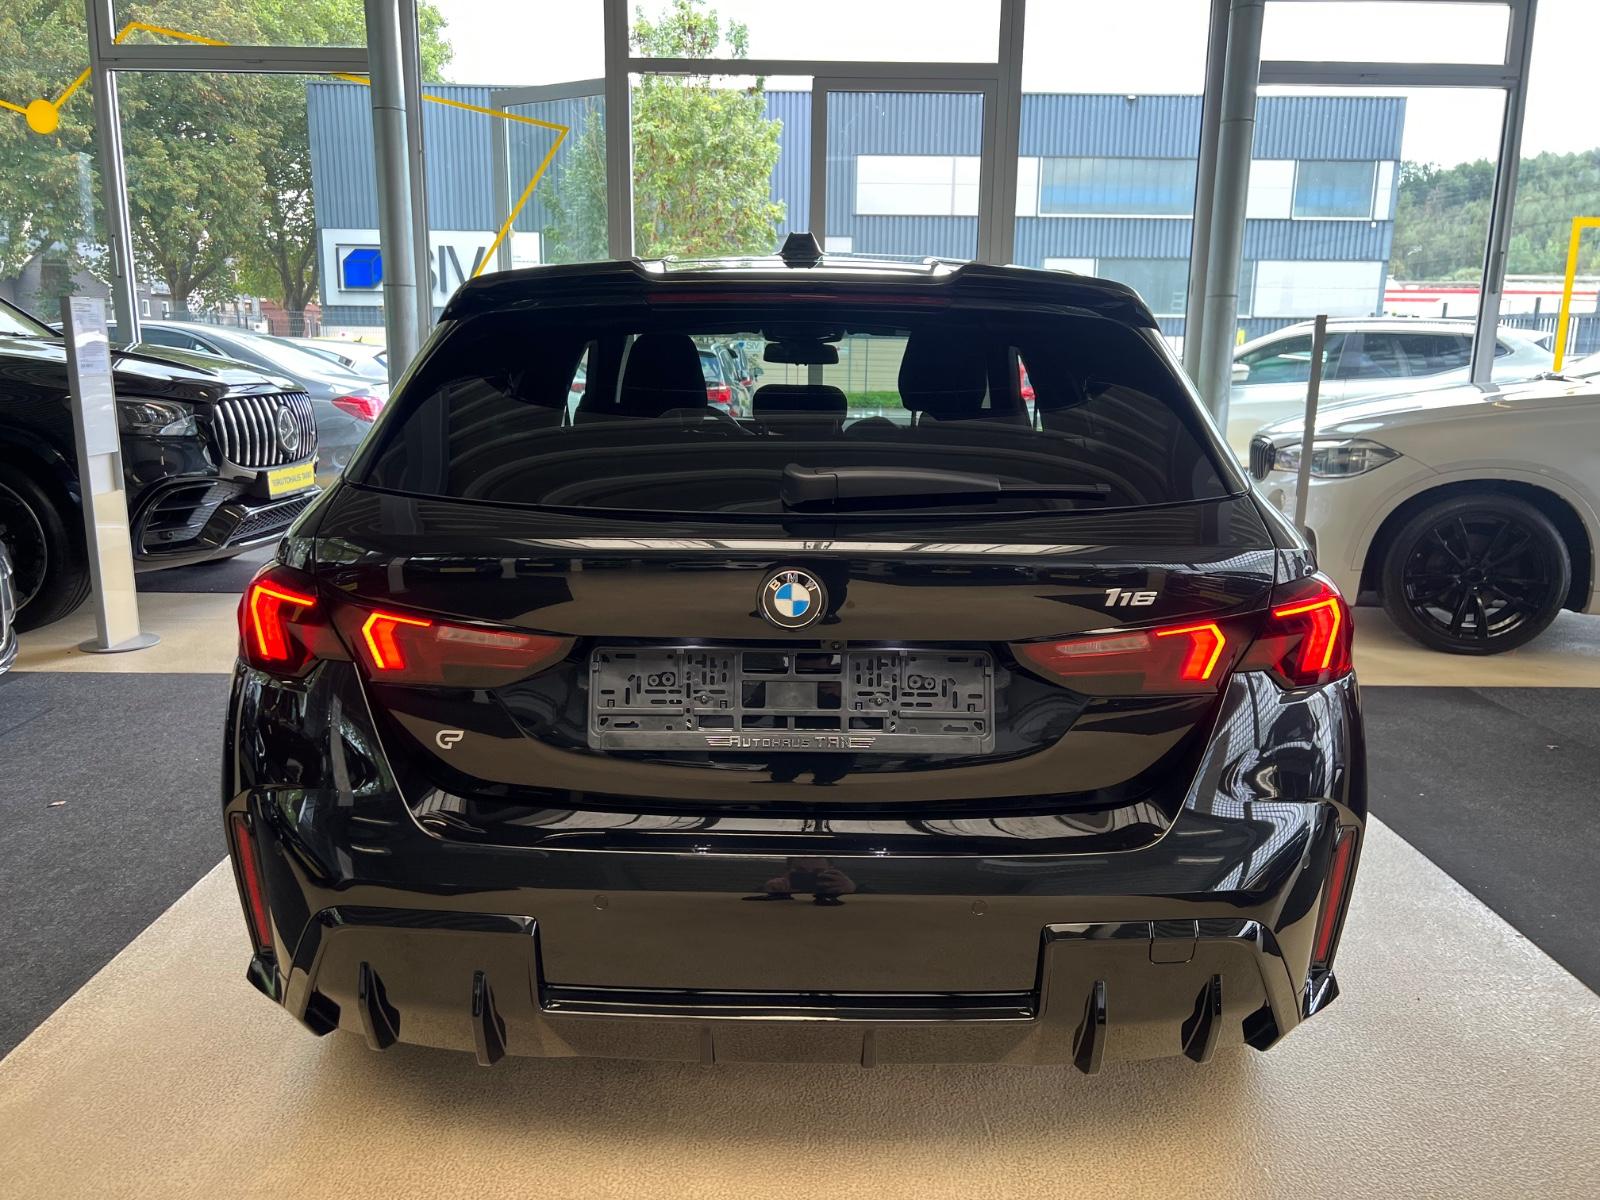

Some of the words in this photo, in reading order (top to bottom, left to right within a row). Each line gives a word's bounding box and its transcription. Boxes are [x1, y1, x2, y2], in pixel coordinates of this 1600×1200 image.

[431, 245, 486, 293] IV
[769, 572, 817, 591] BMW
[1104, 588, 1158, 607] 116
[729, 735, 811, 748] AUTOHAUS
